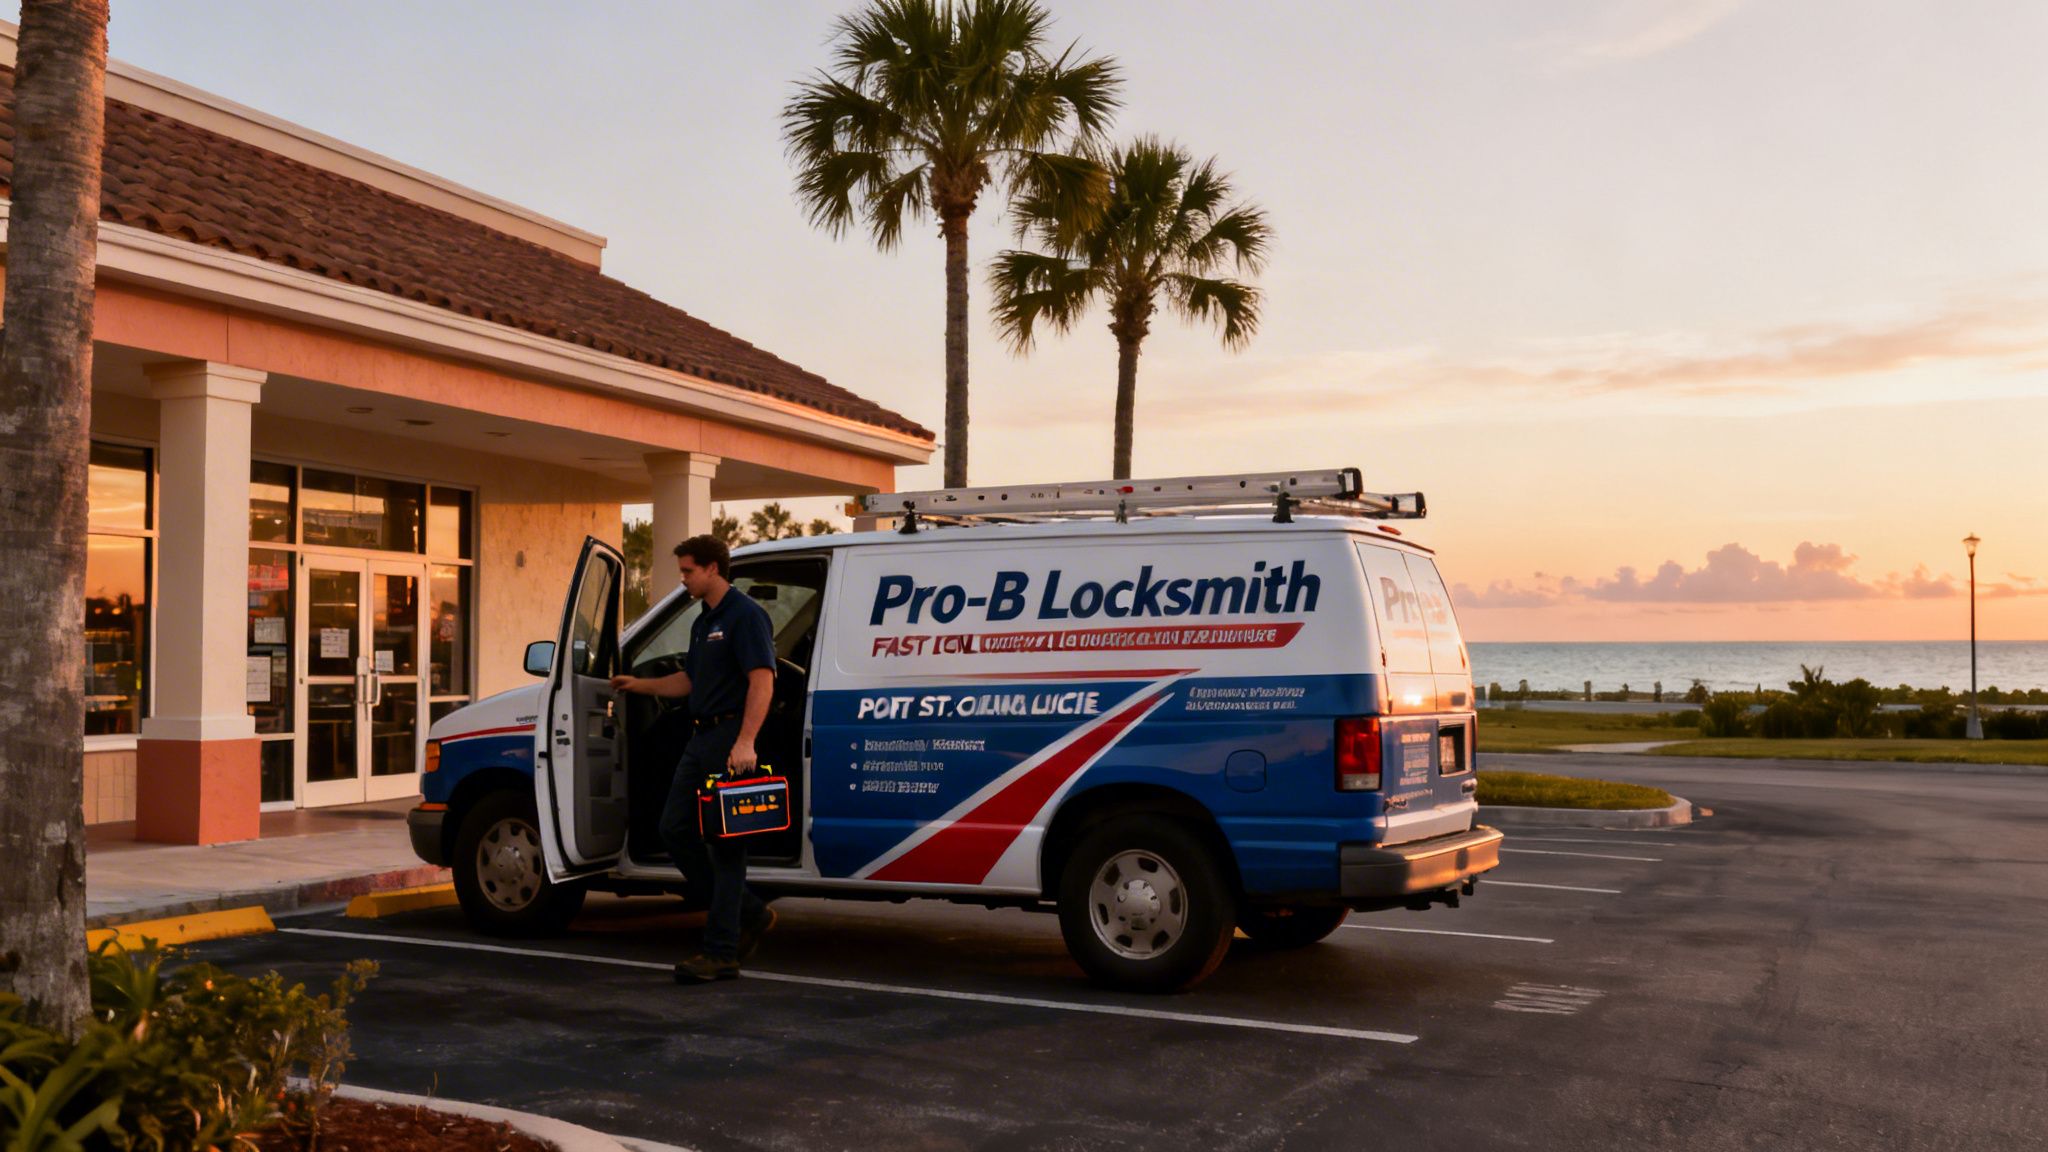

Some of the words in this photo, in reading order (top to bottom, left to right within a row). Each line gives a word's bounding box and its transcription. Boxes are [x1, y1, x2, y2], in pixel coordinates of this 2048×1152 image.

[869, 571, 1029, 625] Pro-B
[1037, 559, 1321, 619] Locksmith
[872, 635, 932, 658] FAST
